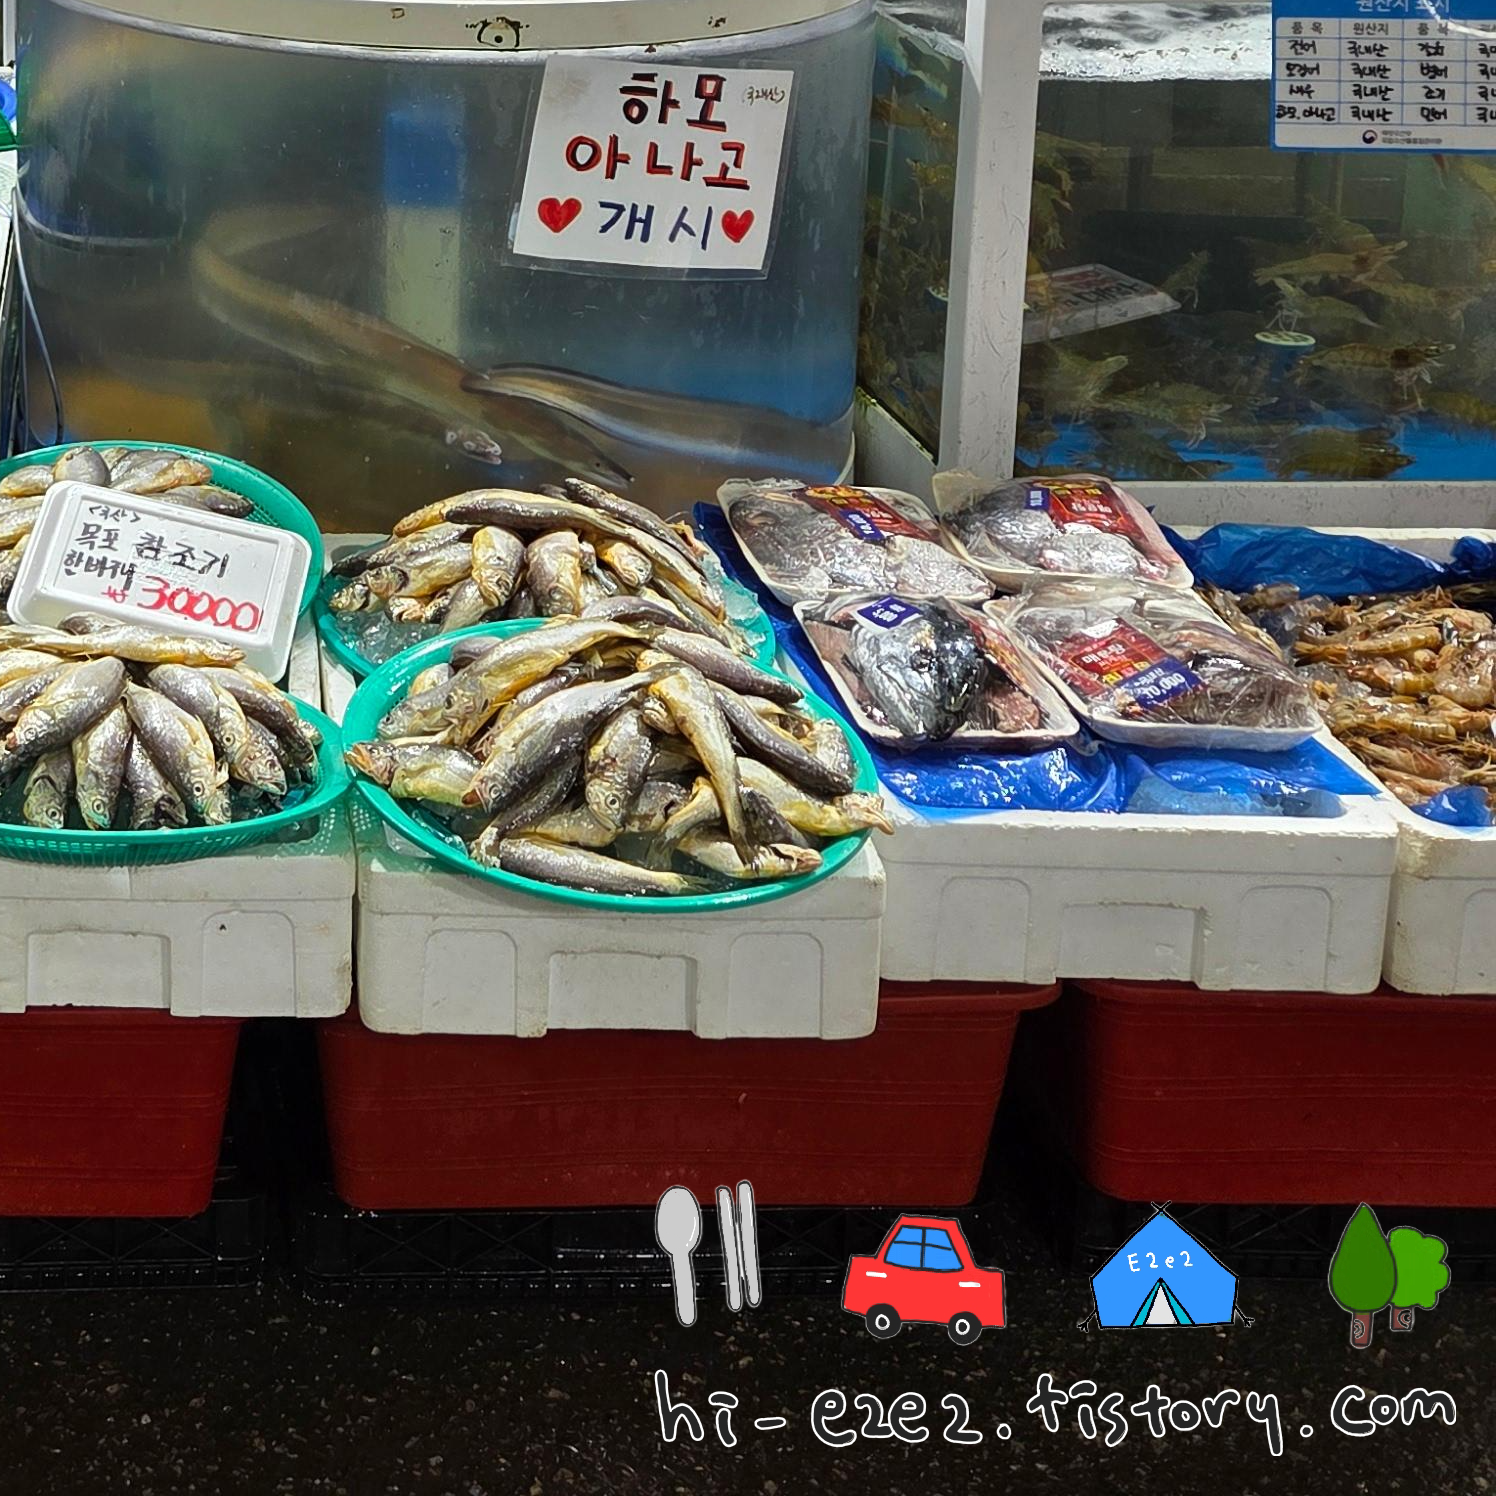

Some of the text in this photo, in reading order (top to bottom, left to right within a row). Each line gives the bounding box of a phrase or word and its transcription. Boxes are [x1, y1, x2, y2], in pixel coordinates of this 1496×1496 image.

[1353, 22, 1389, 35] 원산지
[1288, 39, 1317, 55] 전어
[1347, 40, 1390, 57] 국내산
[1286, 62, 1320, 77] 오징어
[1351, 62, 1392, 79] 국내산
[1289, 84, 1315, 100] 새우
[1352, 83, 1394, 101] 국내산
[618, 72, 727, 133] 하모
[1350, 105, 1393, 122] 국내산
[565, 133, 750, 190] 아나고
[75, 522, 230, 579] 목포 참조기
